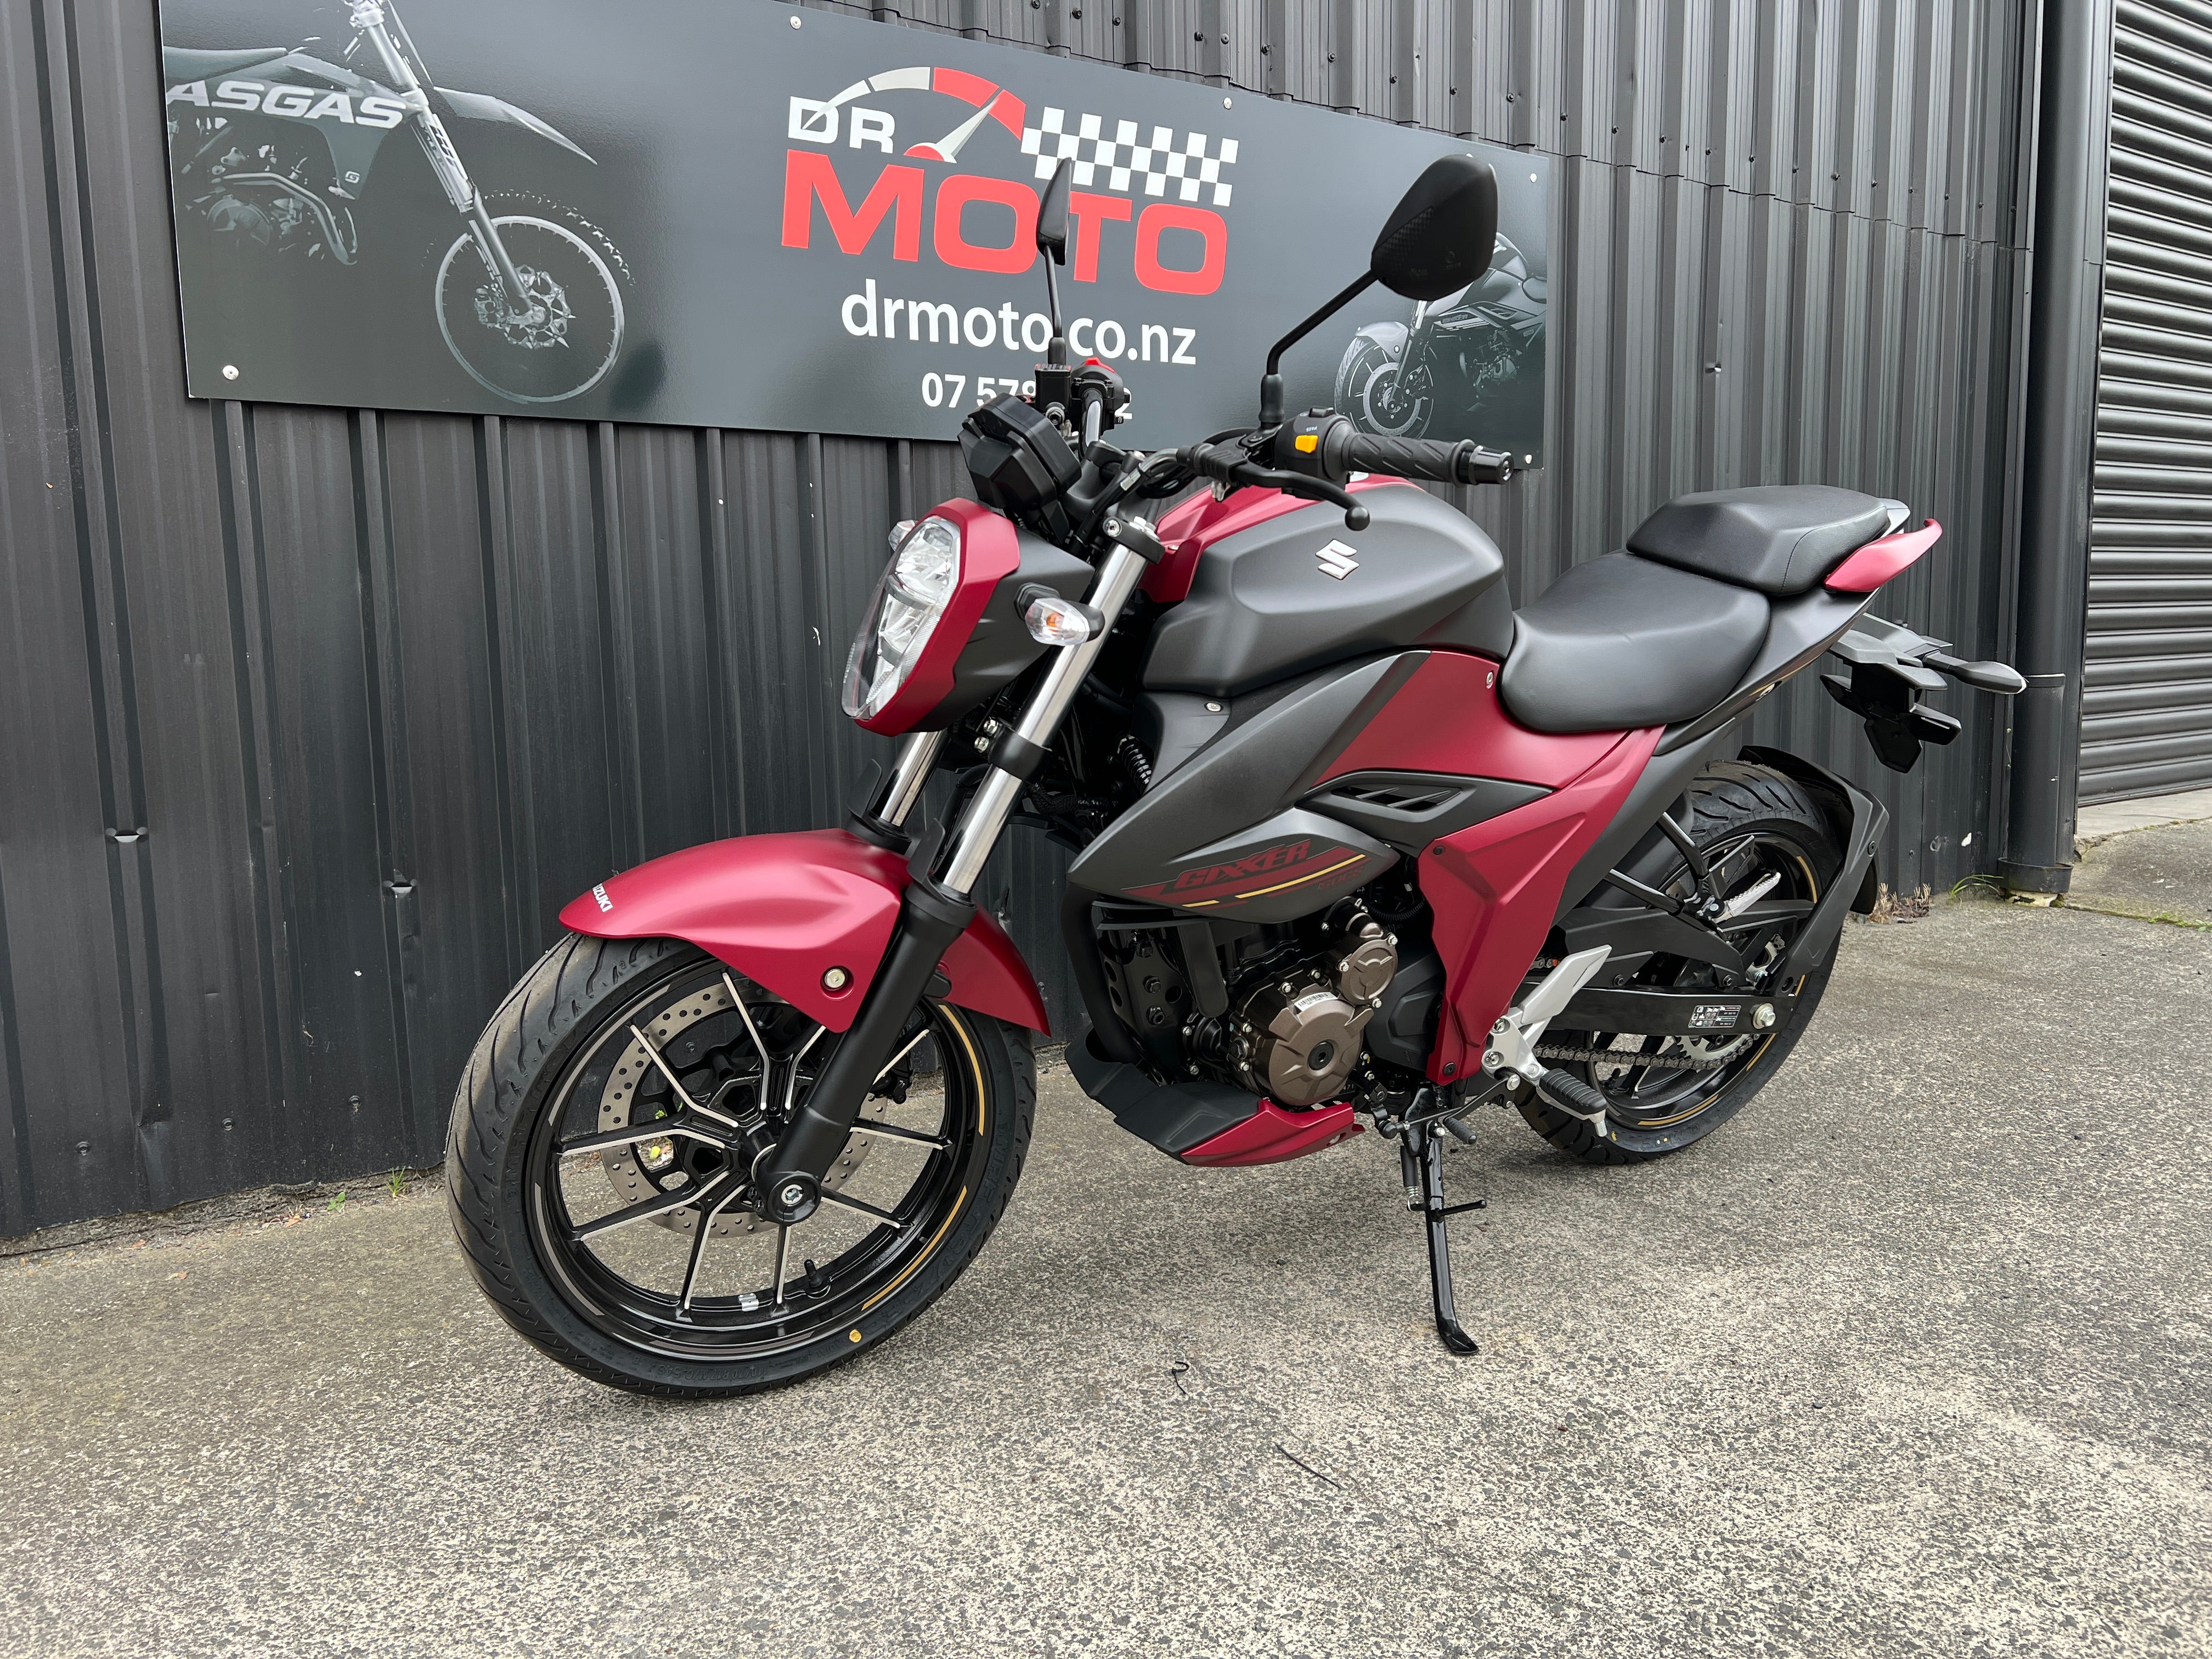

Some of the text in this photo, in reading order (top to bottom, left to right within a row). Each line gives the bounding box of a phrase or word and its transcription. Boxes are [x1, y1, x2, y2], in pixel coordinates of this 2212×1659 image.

[788, 95, 896, 154] DR
[781, 148, 1228, 296] MOTO
[841, 278, 1197, 365] drmotoco.nz
[922, 373, 966, 408] 07
[1173, 839, 1311, 889] GIXXER
[592, 883, 614, 912] UZUKI
